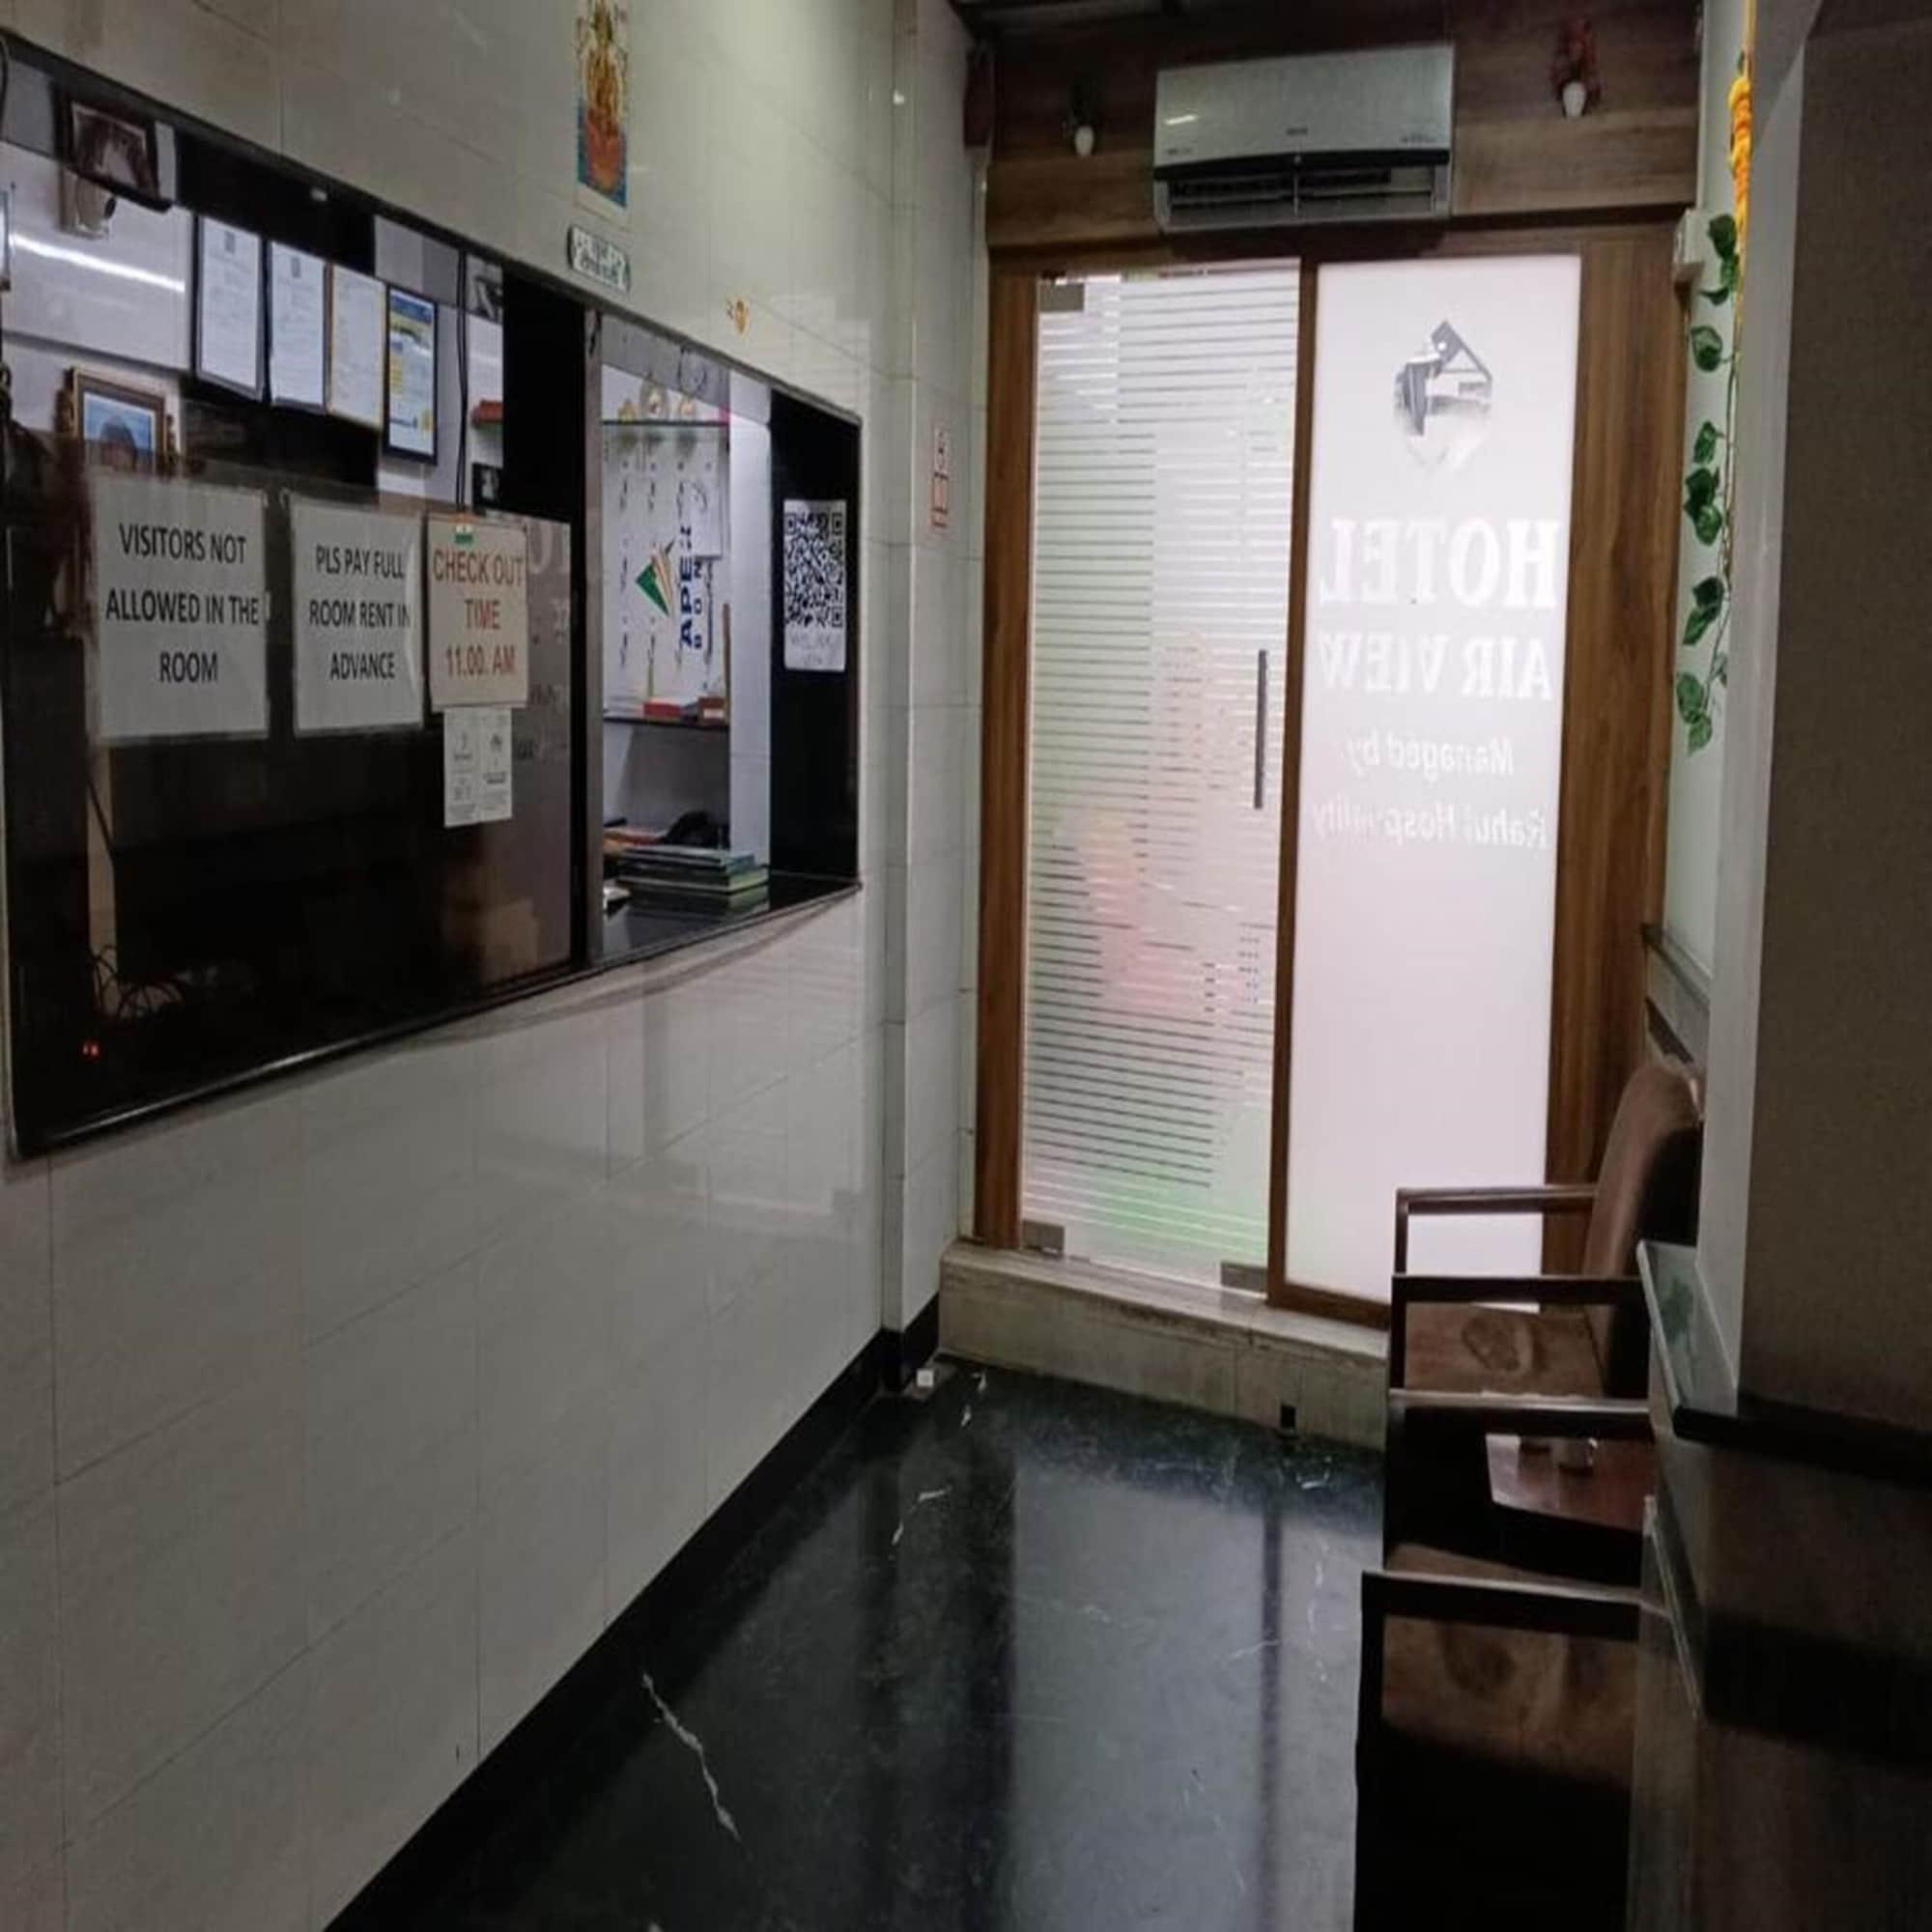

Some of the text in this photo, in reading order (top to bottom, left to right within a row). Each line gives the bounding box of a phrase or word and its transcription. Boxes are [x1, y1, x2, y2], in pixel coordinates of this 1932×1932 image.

[119, 523, 246, 564] VISITORS NOT
[316, 544, 404, 580] PLS PAY FULL
[433, 550, 524, 587] CHECK OUT
[105, 587, 259, 626] ALLOWED IN THE
[309, 599, 355, 627] ROOM
[358, 601, 394, 628] RENT
[465, 599, 500, 631] TIME
[159, 651, 218, 684] ROOM
[330, 651, 395, 681] ADVANCE
[493, 644, 515, 675] AM
